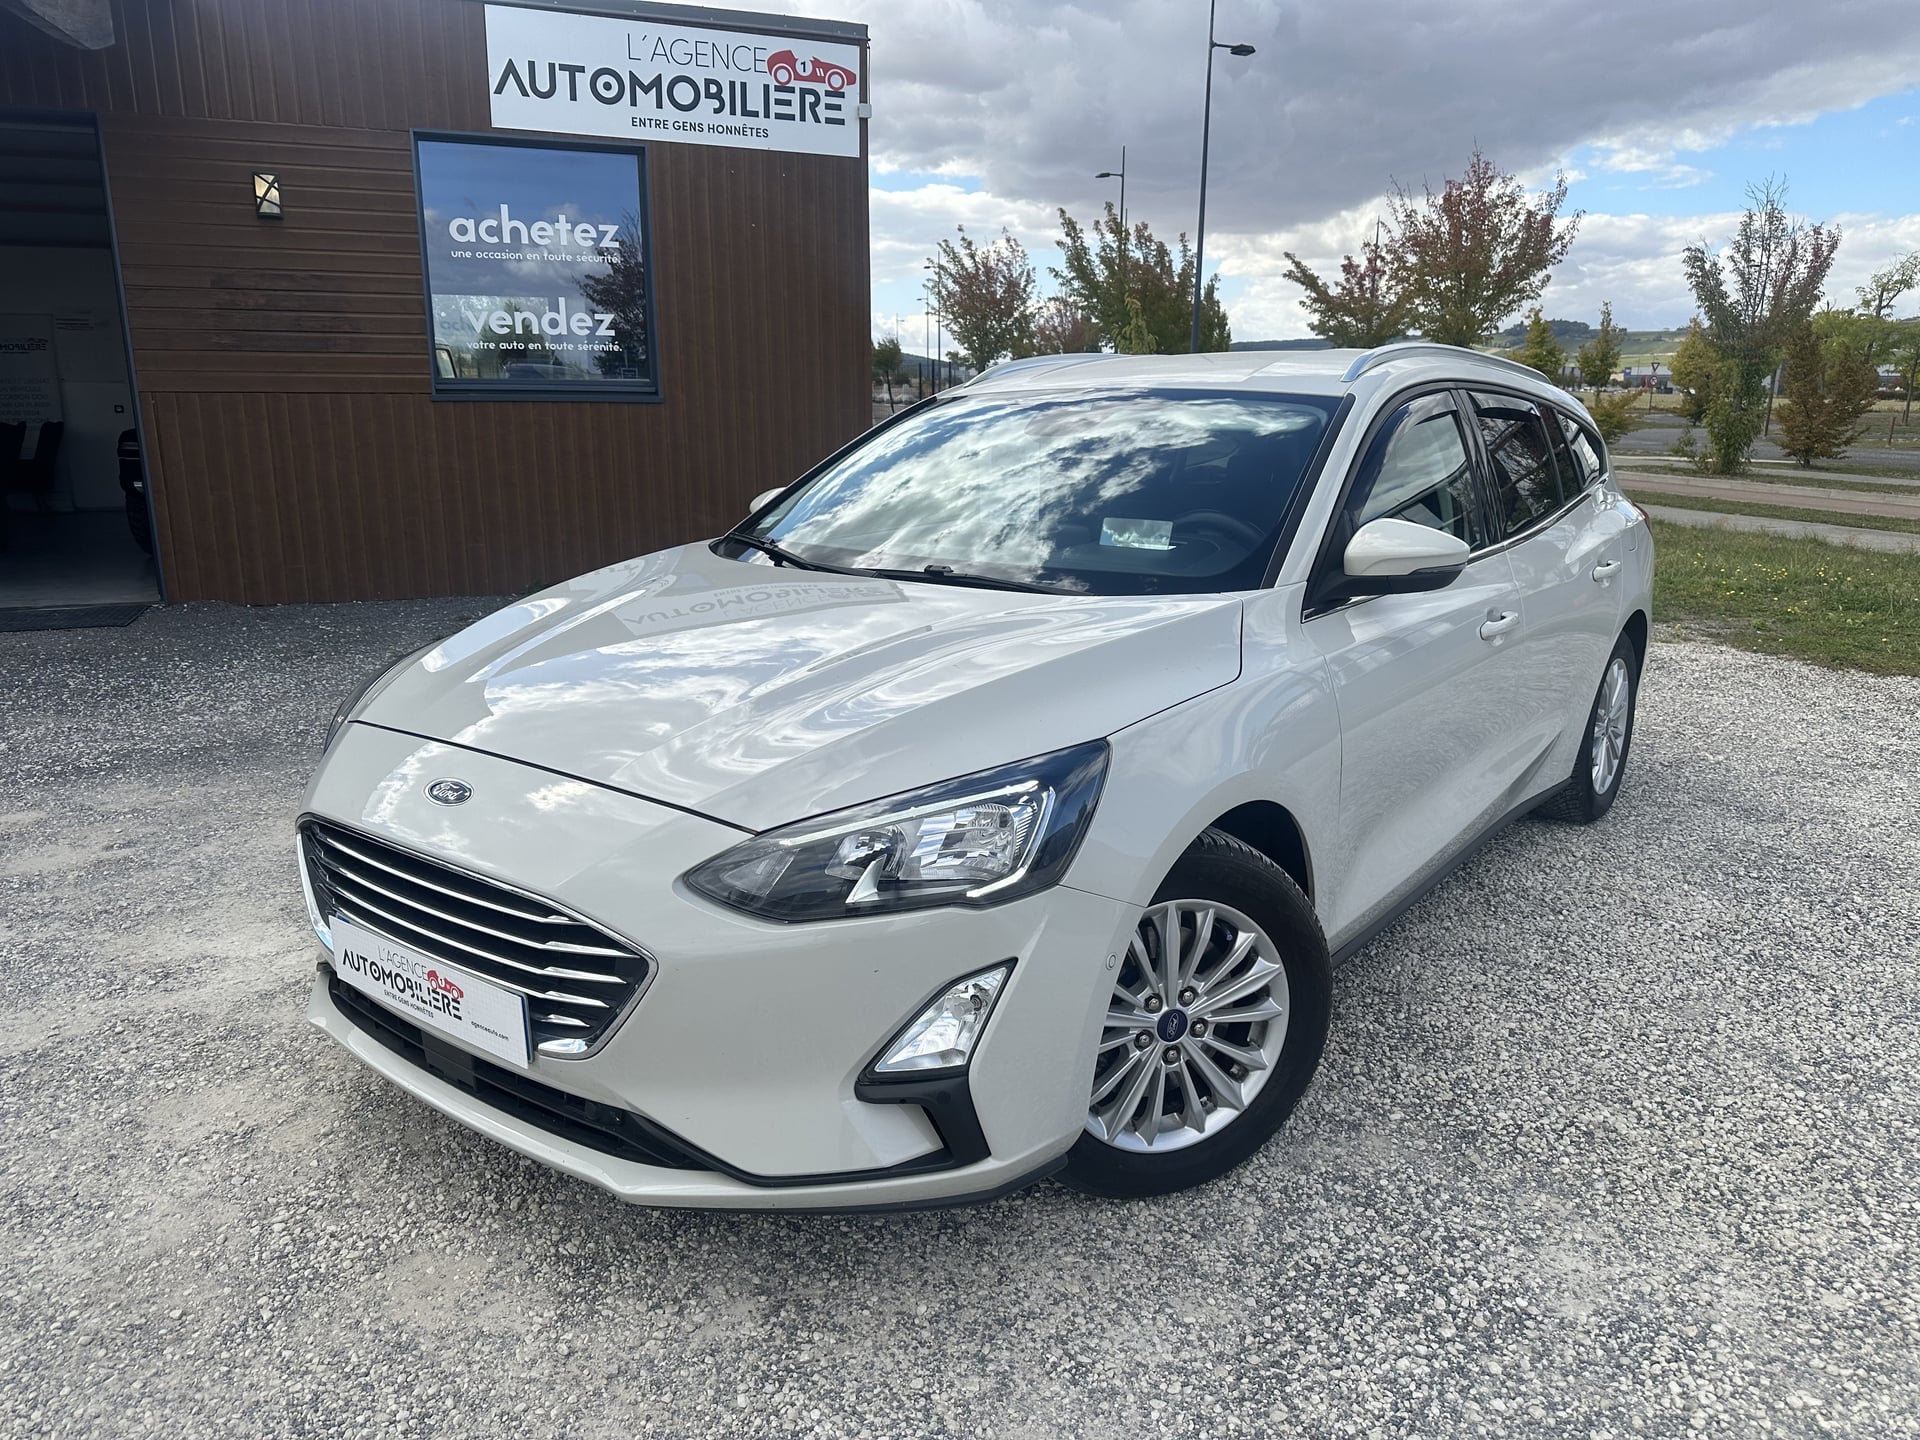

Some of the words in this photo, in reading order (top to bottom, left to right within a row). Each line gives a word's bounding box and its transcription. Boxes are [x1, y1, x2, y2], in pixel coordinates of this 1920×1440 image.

[800, 60, 806, 73] 1
[493, 58, 845, 126] AUTOMOBILIERE
[631, 116, 670, 130] ENTRE
[672, 120, 704, 133] GENS
[707, 123, 769, 138] HONNÊTES
[449, 203, 620, 248] achetez
[451, 250, 472, 258] une
[475, 249, 523, 260] occasion
[543, 251, 573, 262] toute
[464, 297, 616, 337] vendez
[466, 340, 496, 350] votre
[499, 340, 525, 350] auto
[528, 342, 542, 350] en
[544, 340, 574, 351] toute
[577, 340, 623, 352] sérénité.
[430, 781, 466, 801] Ford
[342, 948, 463, 1021] AUTOMOBILIERE
[383, 989, 398, 1001] ENTRE
[398, 996, 410, 1007] GENS
